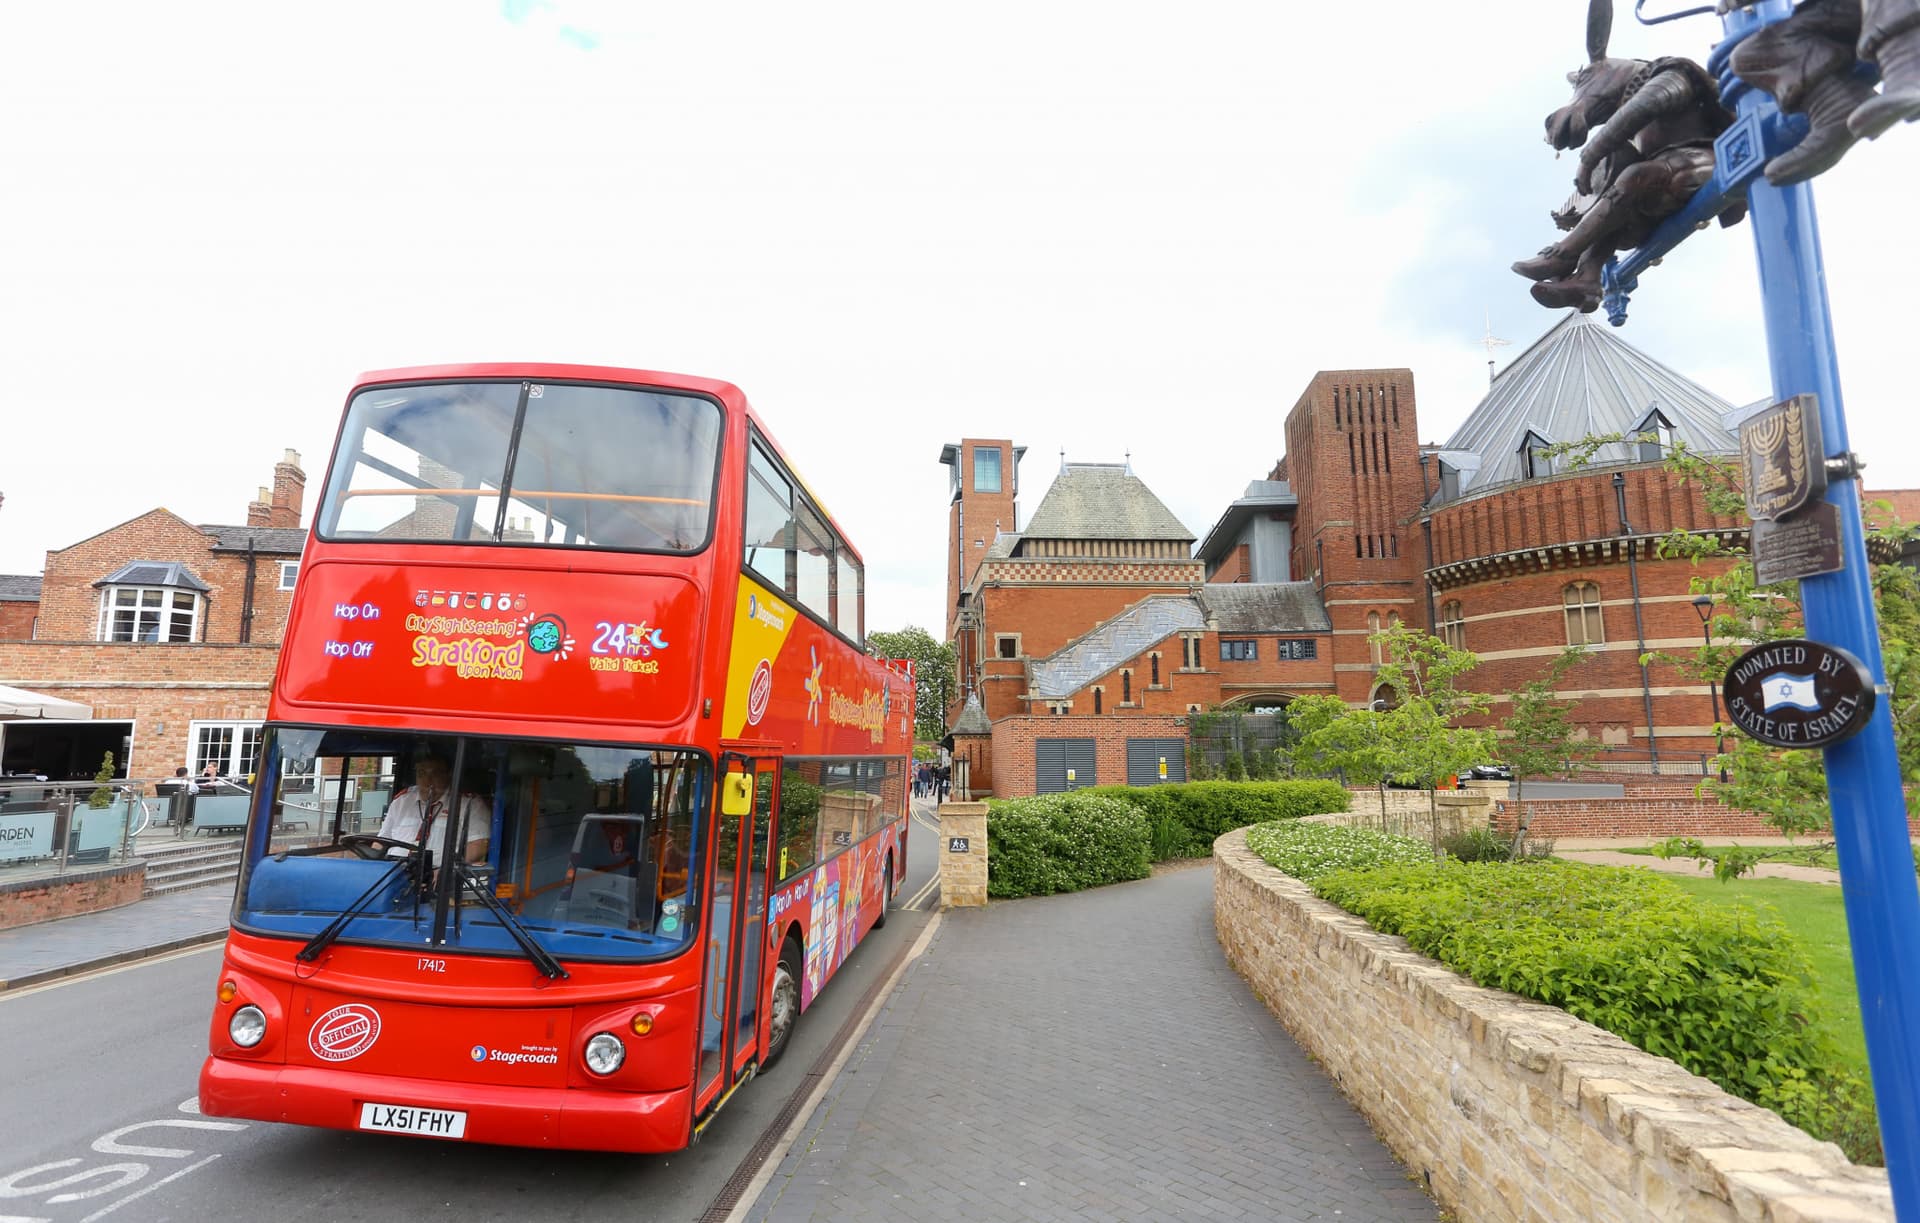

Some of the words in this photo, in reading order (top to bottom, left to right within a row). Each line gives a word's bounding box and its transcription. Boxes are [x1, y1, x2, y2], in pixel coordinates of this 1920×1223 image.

[335, 603, 359, 620] Hop
[362, 603, 380, 619] On
[325, 641, 350, 657] Hop
[352, 641, 374, 657] Off
[412, 635, 525, 667] Stratford
[457, 663, 490, 679] Upon
[492, 665, 523, 680] Avon
[589, 656, 620, 672] Valid
[622, 657, 659, 674] Ticket
[1734, 647, 1807, 685] DONATED
[1819, 653, 1844, 677] BY
[1732, 696, 1775, 738] STATE
[1778, 723, 1798, 741] OF
[1803, 695, 1860, 740] ISRAEL
[0, 826, 35, 841] RDEN
[417, 959, 446, 973] 17412
[321, 1021, 367, 1045] OFFICIAL
[490, 1049, 558, 1065] Stagecoach
[371, 1106, 415, 1129] LX51
[417, 1111, 455, 1133] FHY
